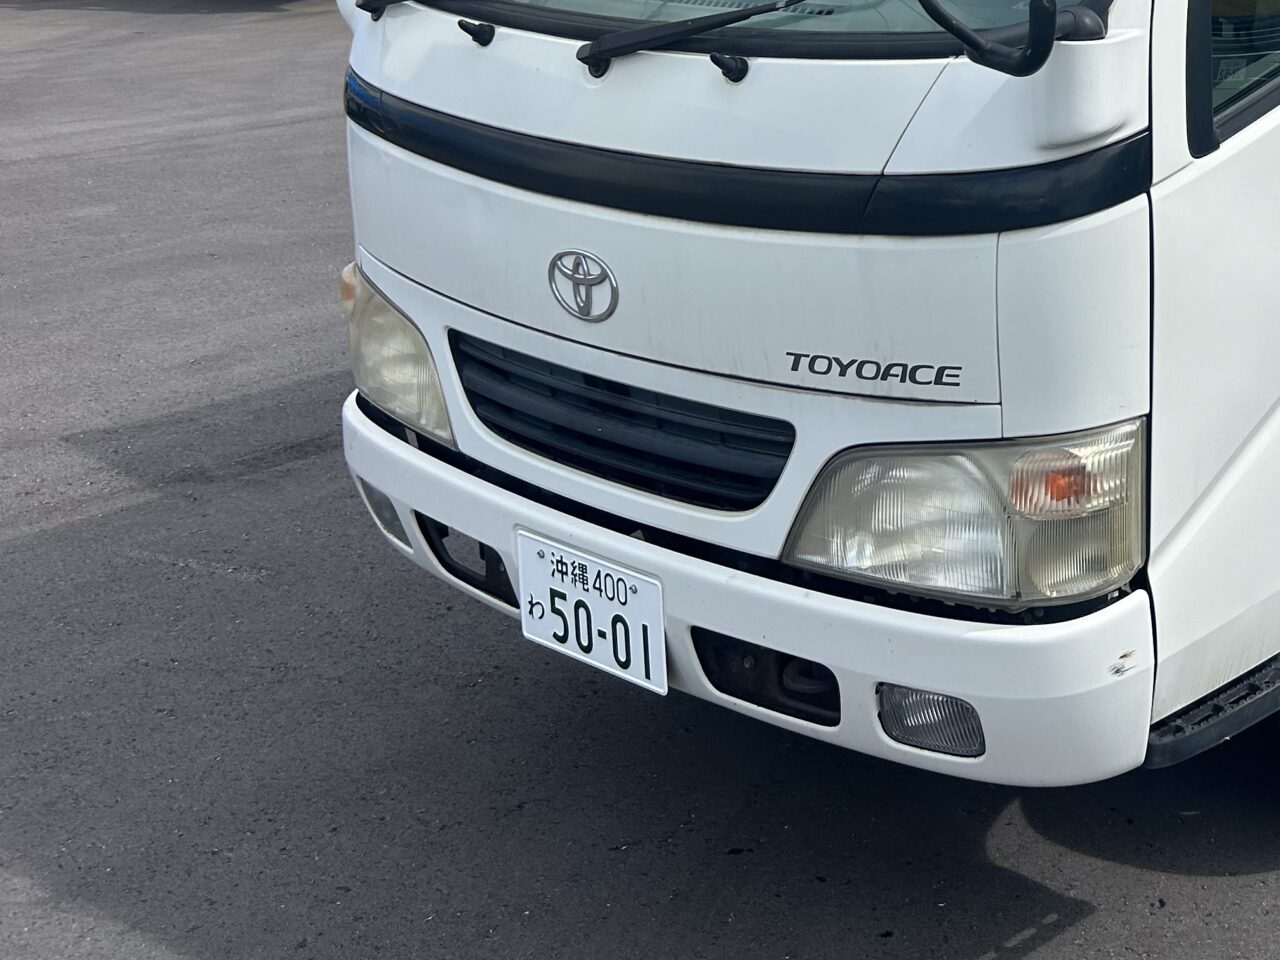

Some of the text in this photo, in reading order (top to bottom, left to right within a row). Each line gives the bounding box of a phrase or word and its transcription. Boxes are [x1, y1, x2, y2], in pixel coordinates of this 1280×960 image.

[785, 351, 963, 387] TOYOACE
[527, 587, 651, 681] わ 50-01
